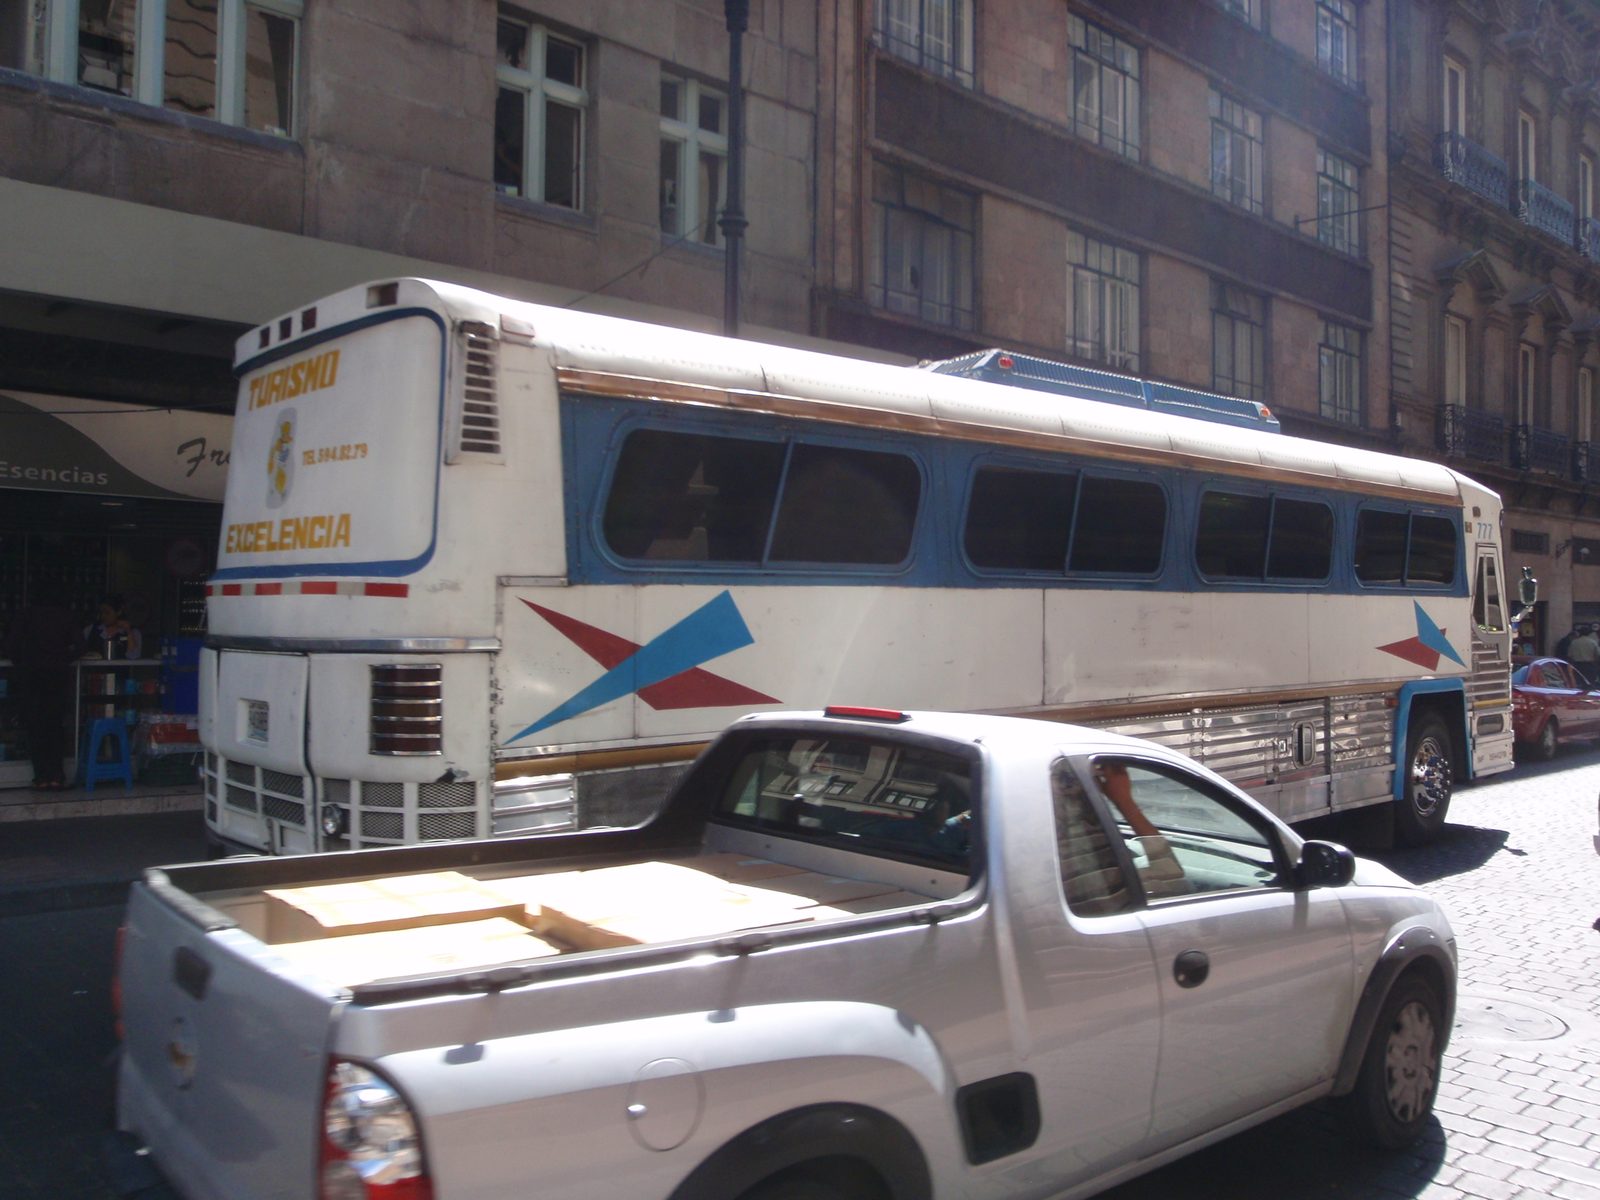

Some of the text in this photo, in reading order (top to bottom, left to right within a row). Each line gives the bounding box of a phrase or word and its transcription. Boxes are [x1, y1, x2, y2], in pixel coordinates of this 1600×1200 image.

[249, 350, 341, 411] TURISMO
[226, 513, 352, 554] EXCELENCIA
[1477, 522, 1493, 540] 777
